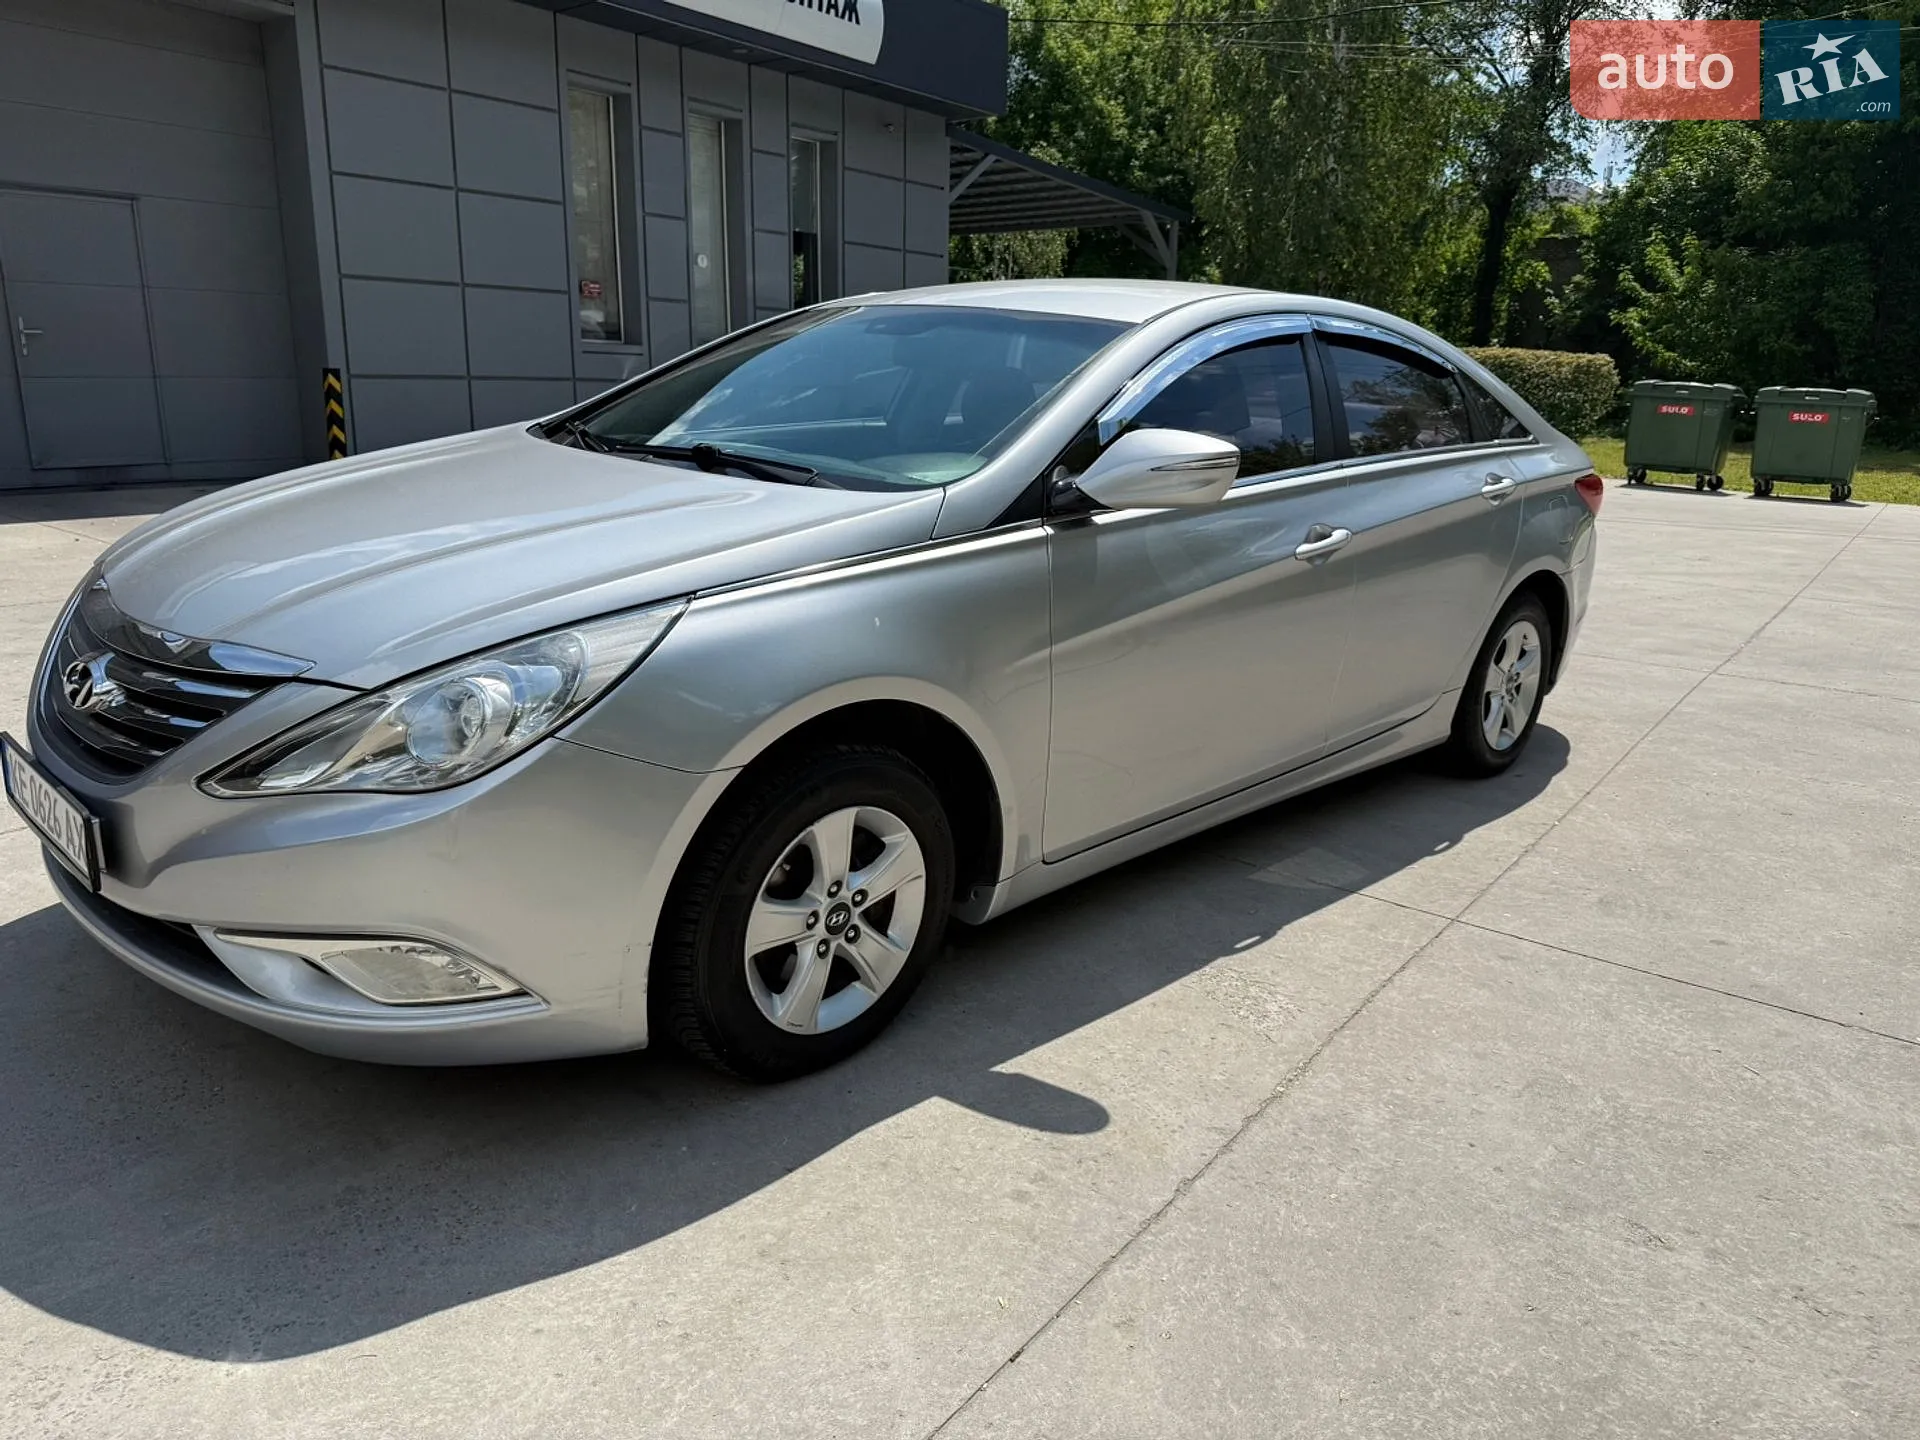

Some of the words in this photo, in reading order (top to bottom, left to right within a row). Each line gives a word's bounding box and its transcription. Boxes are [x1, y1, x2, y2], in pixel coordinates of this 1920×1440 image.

[1661, 405, 1689, 415] SULO
[1792, 413, 1824, 422] SULO
[29, 775, 62, 840] 0626
[65, 807, 87, 863] AX
